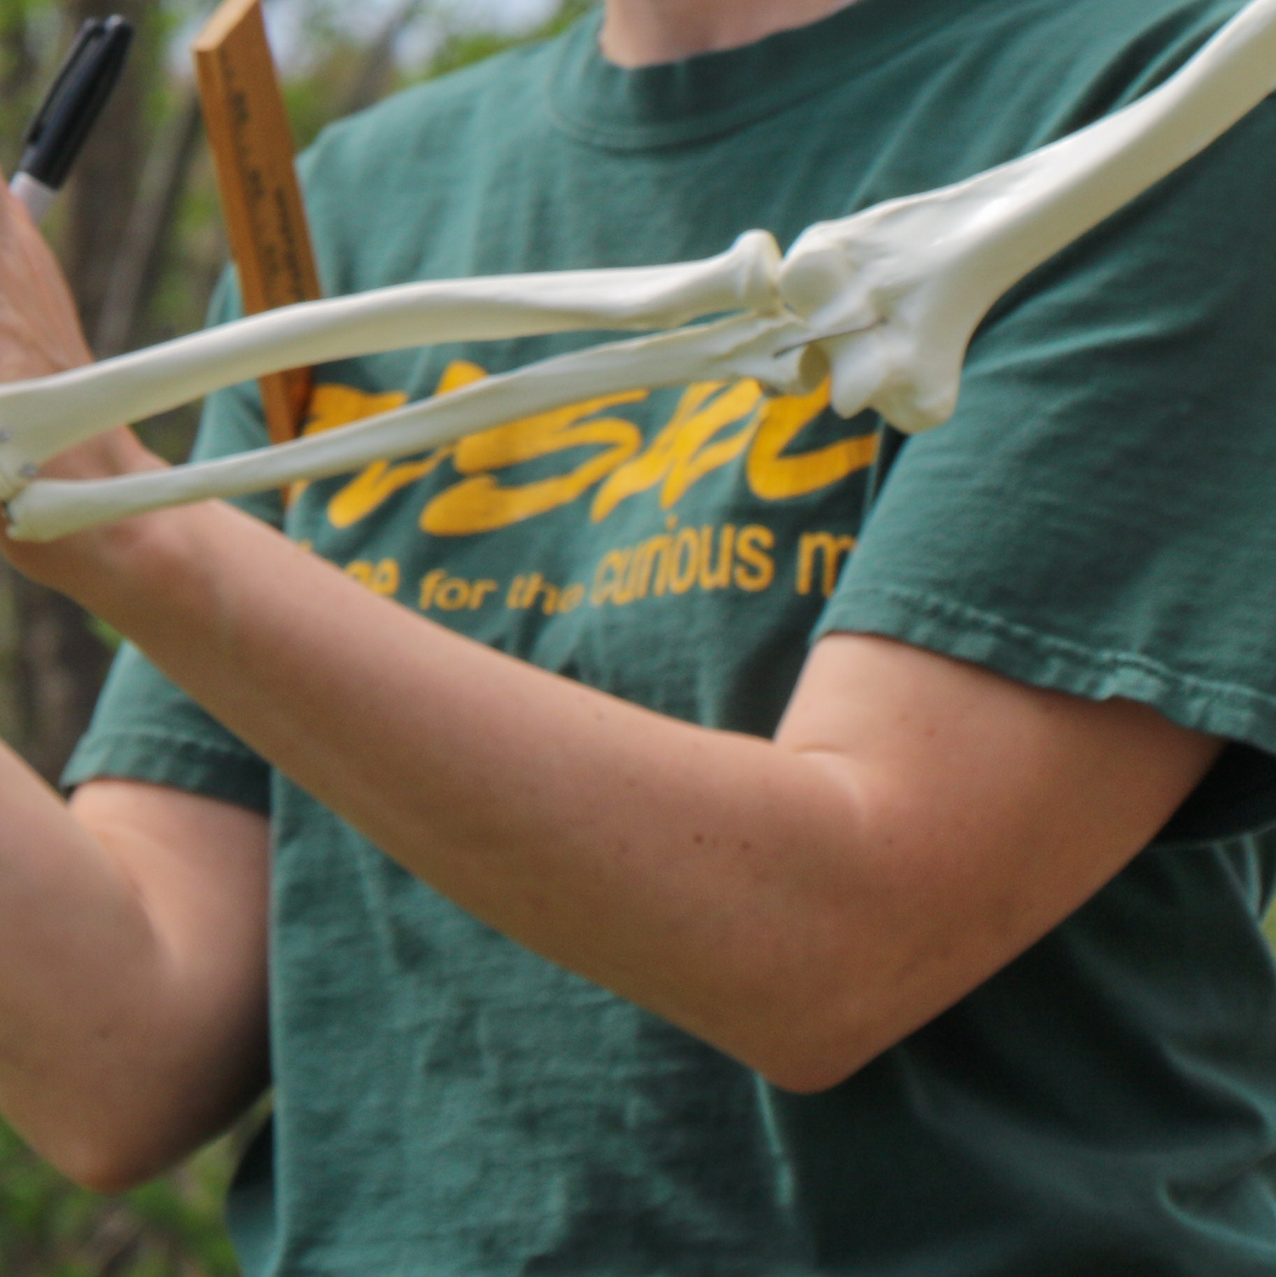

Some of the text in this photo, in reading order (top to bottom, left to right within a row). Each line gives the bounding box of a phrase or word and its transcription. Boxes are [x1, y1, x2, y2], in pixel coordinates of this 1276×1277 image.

[418, 569, 498, 611] for
[507, 572, 585, 615] the
[590, 515, 775, 607] curious
